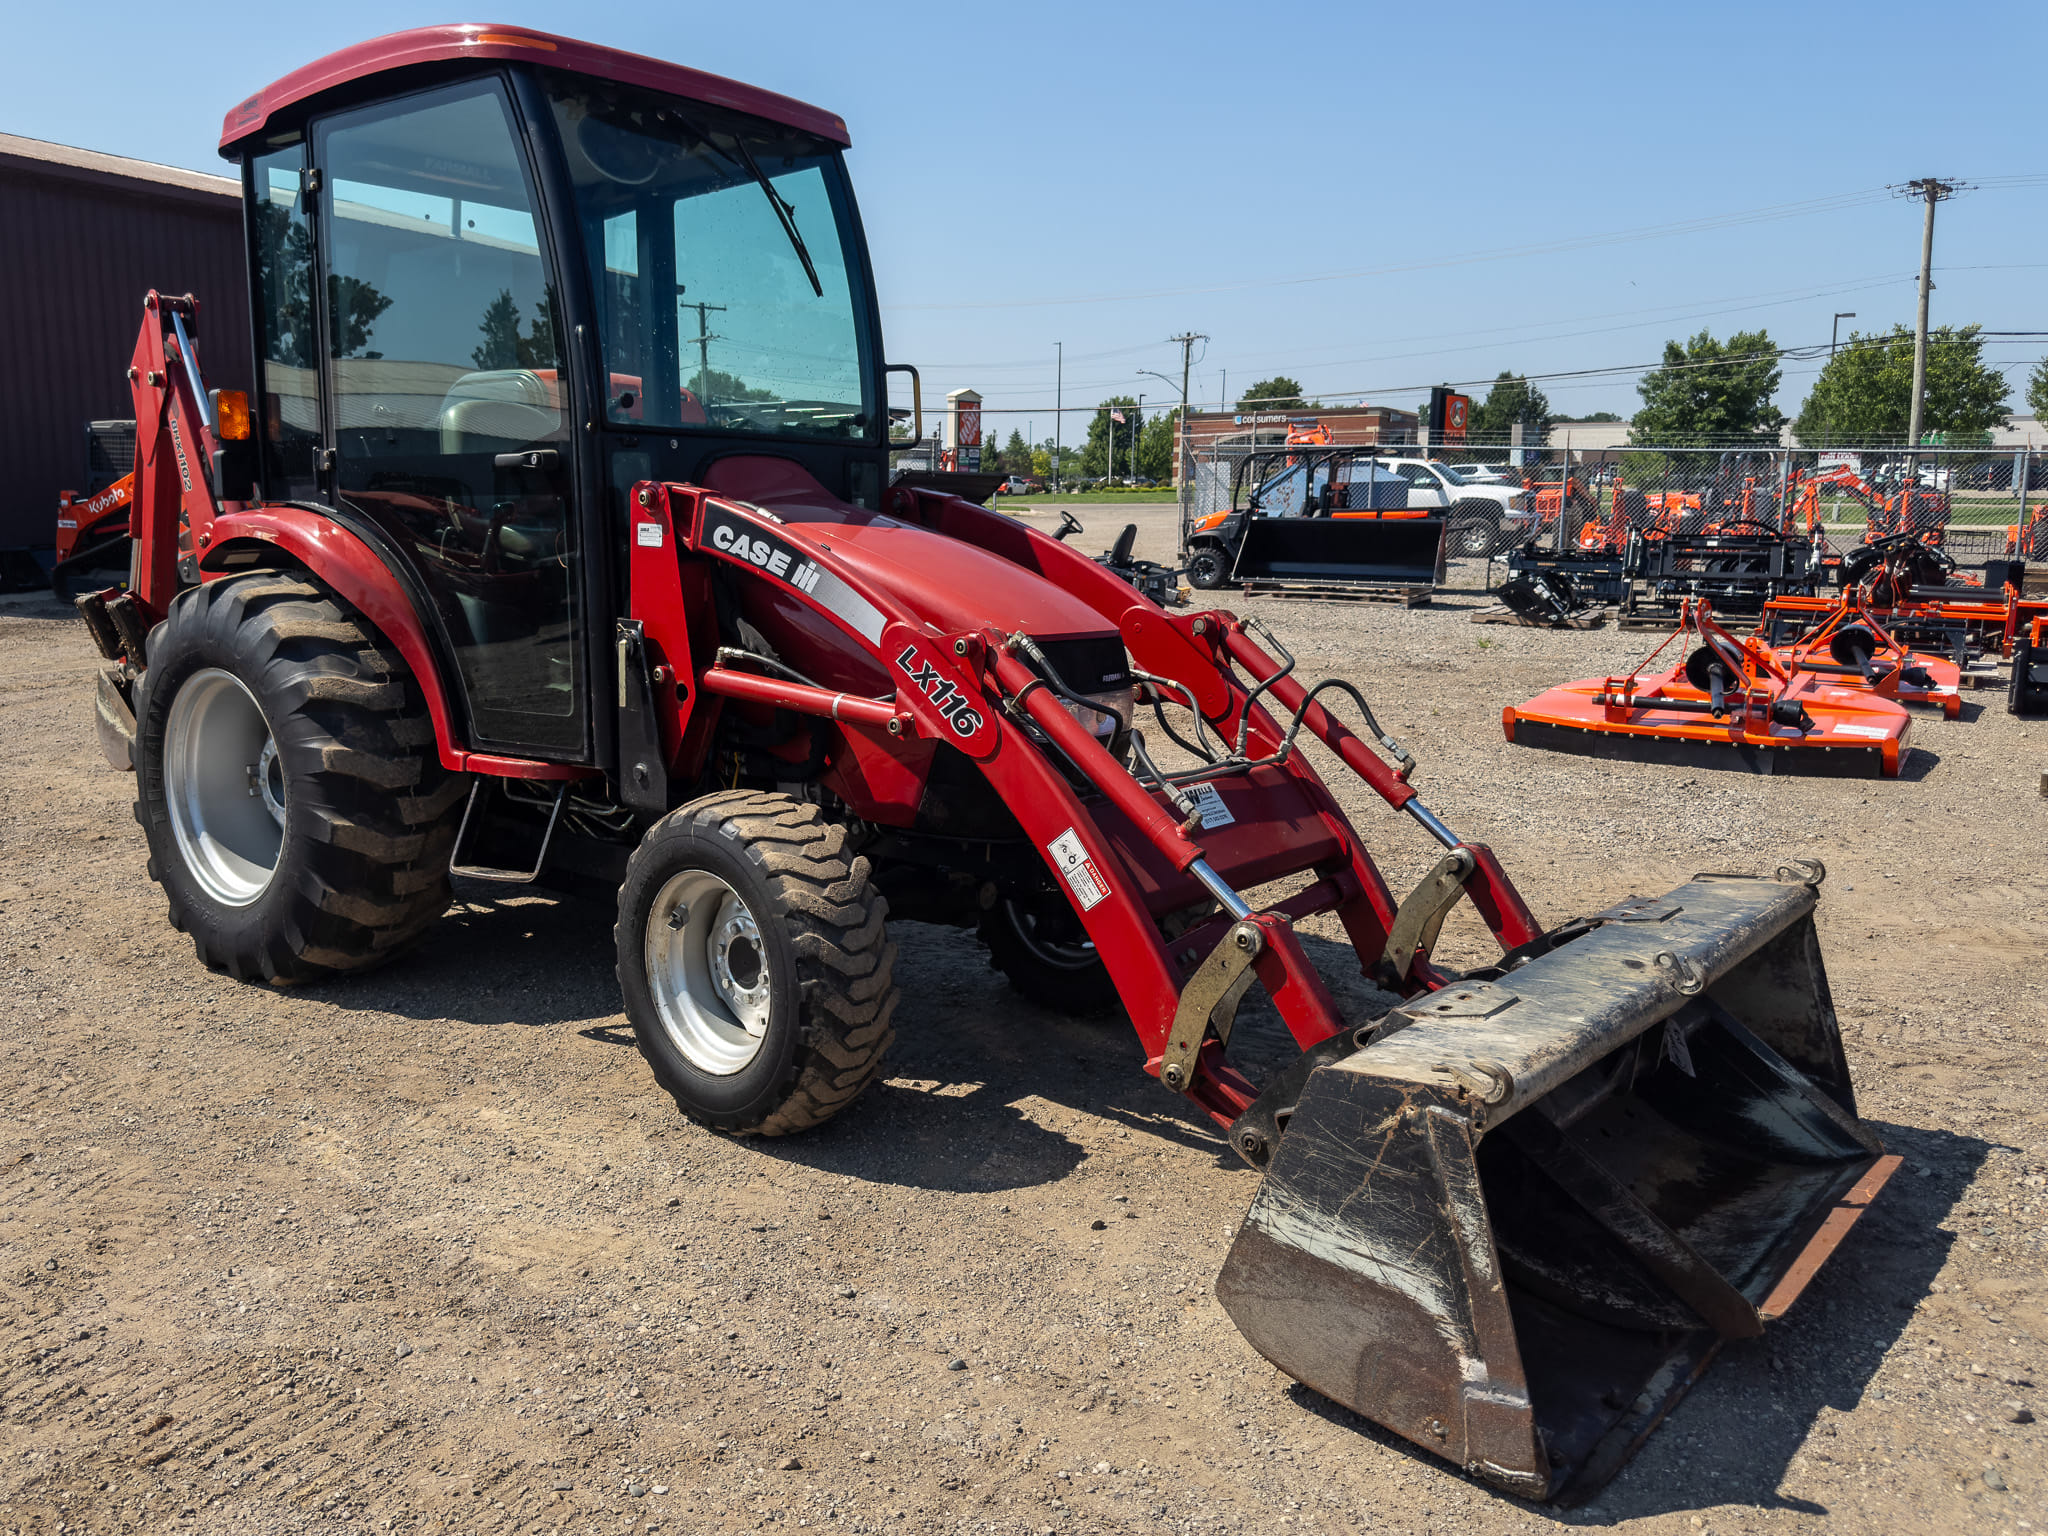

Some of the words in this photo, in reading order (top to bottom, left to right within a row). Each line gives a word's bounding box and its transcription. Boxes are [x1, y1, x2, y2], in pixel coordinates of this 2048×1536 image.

[170, 419, 192, 492] BHX1102
[88, 488, 125, 513] Kubota
[712, 525, 791, 577] CASE
[896, 643, 984, 738] LX116
[1089, 867, 1108, 895] DANGER
